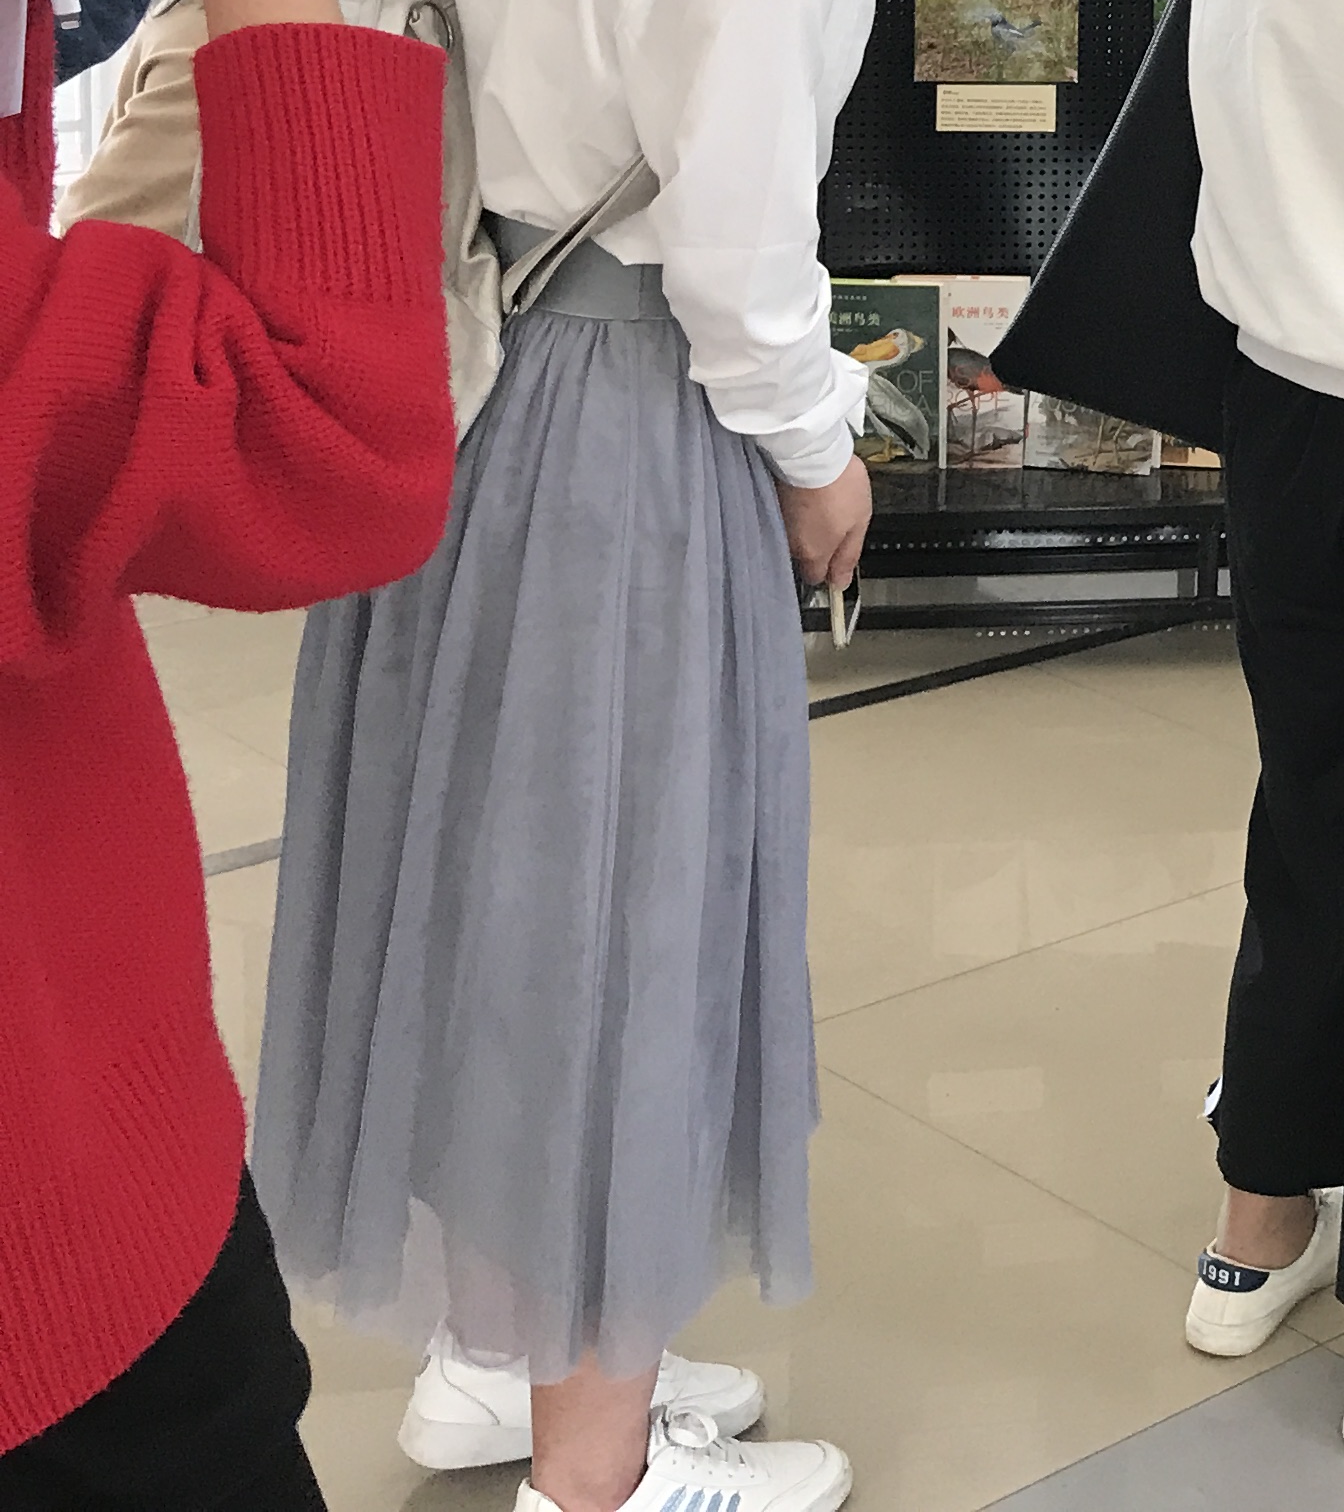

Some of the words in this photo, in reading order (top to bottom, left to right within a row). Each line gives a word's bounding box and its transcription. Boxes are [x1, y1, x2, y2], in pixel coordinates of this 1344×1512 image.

[952, 306, 1010, 319] 欧洲鸟类
[897, 370, 934, 393] OF
[1202, 1262, 1241, 1286] 1991
